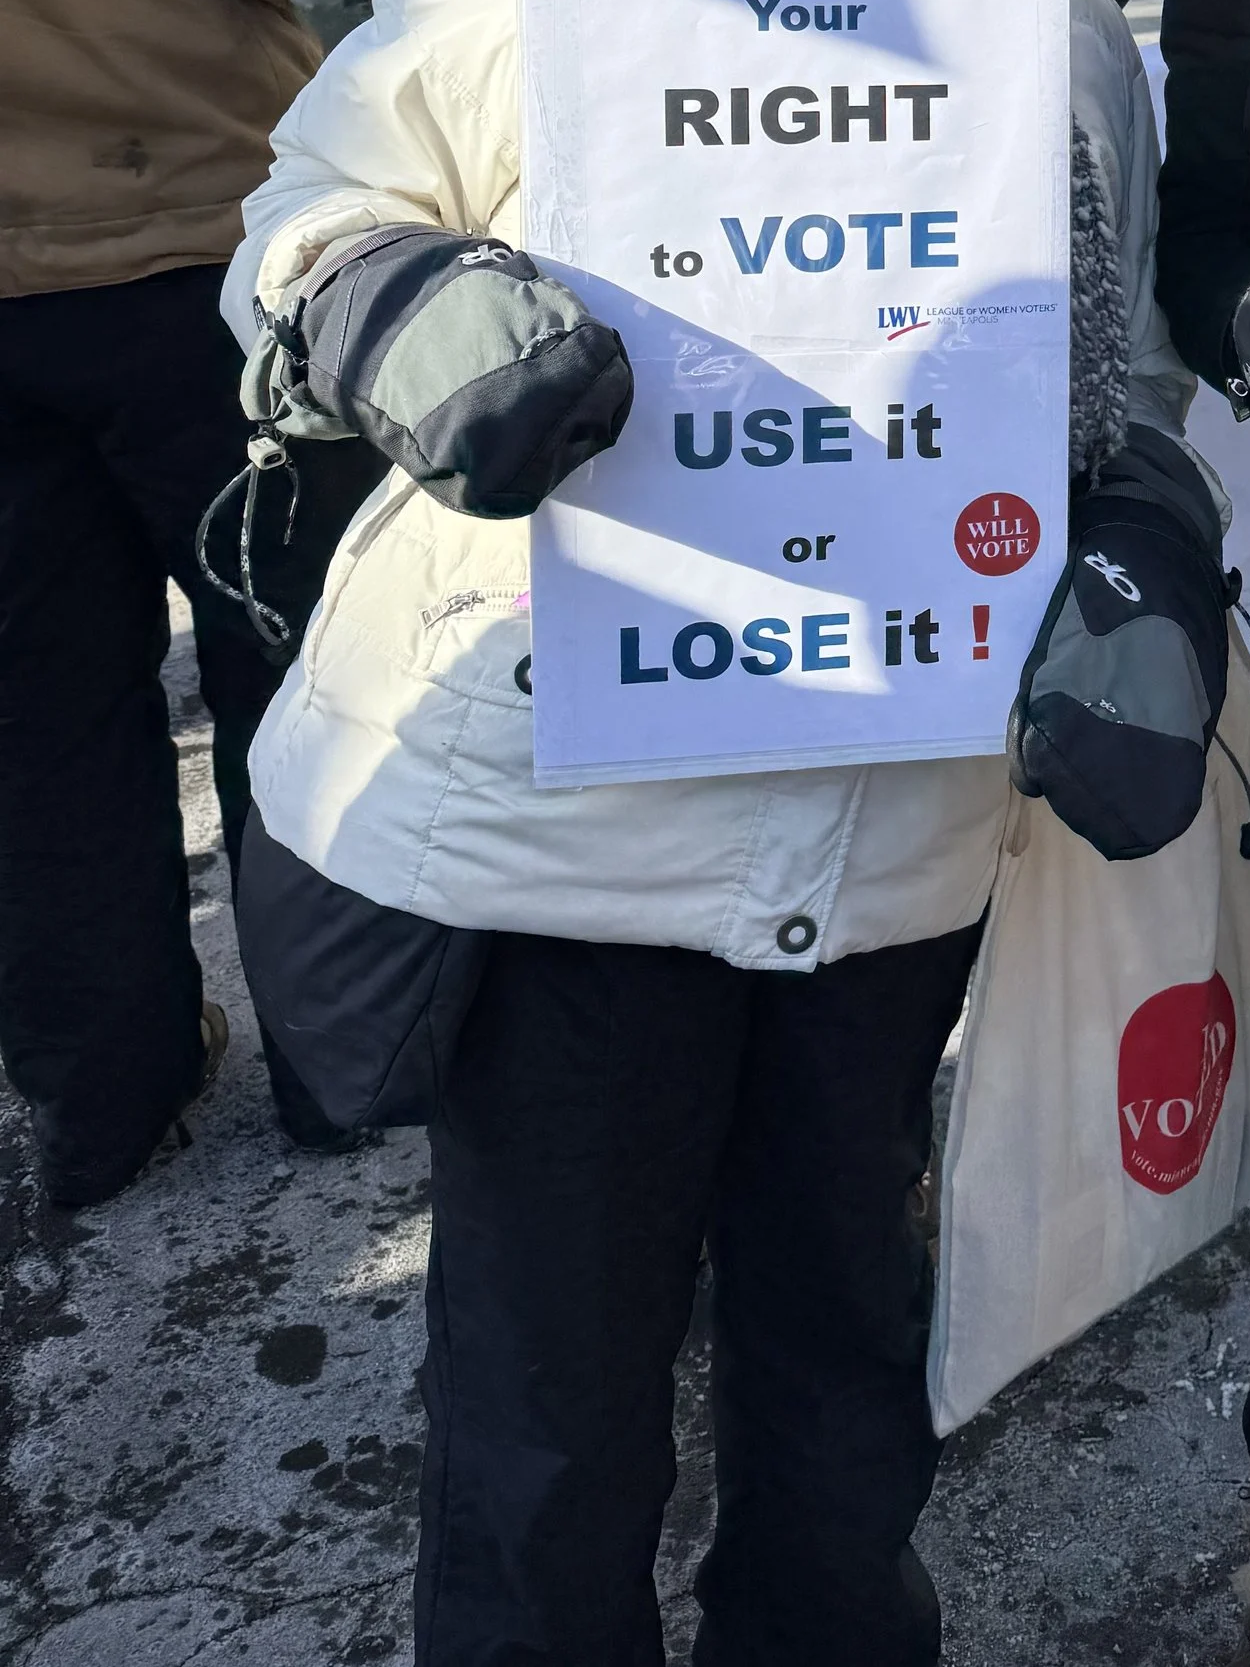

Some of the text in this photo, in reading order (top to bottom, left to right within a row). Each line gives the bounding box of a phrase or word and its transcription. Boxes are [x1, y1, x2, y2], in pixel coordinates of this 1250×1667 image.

[664, 84, 949, 147] RIGHT
[650, 210, 959, 279] to VOTE
[877, 305, 921, 329] LWV
[926, 307, 965, 316] LEAGUE
[979, 305, 1018, 315] WOMEN
[674, 403, 943, 470] USE it
[992, 500, 1000, 517] I
[967, 518, 1029, 539] WILL
[782, 533, 836, 563] or
[966, 538, 1030, 560] VOTE
[620, 612, 851, 685] LOSE
[884, 608, 940, 666] it
